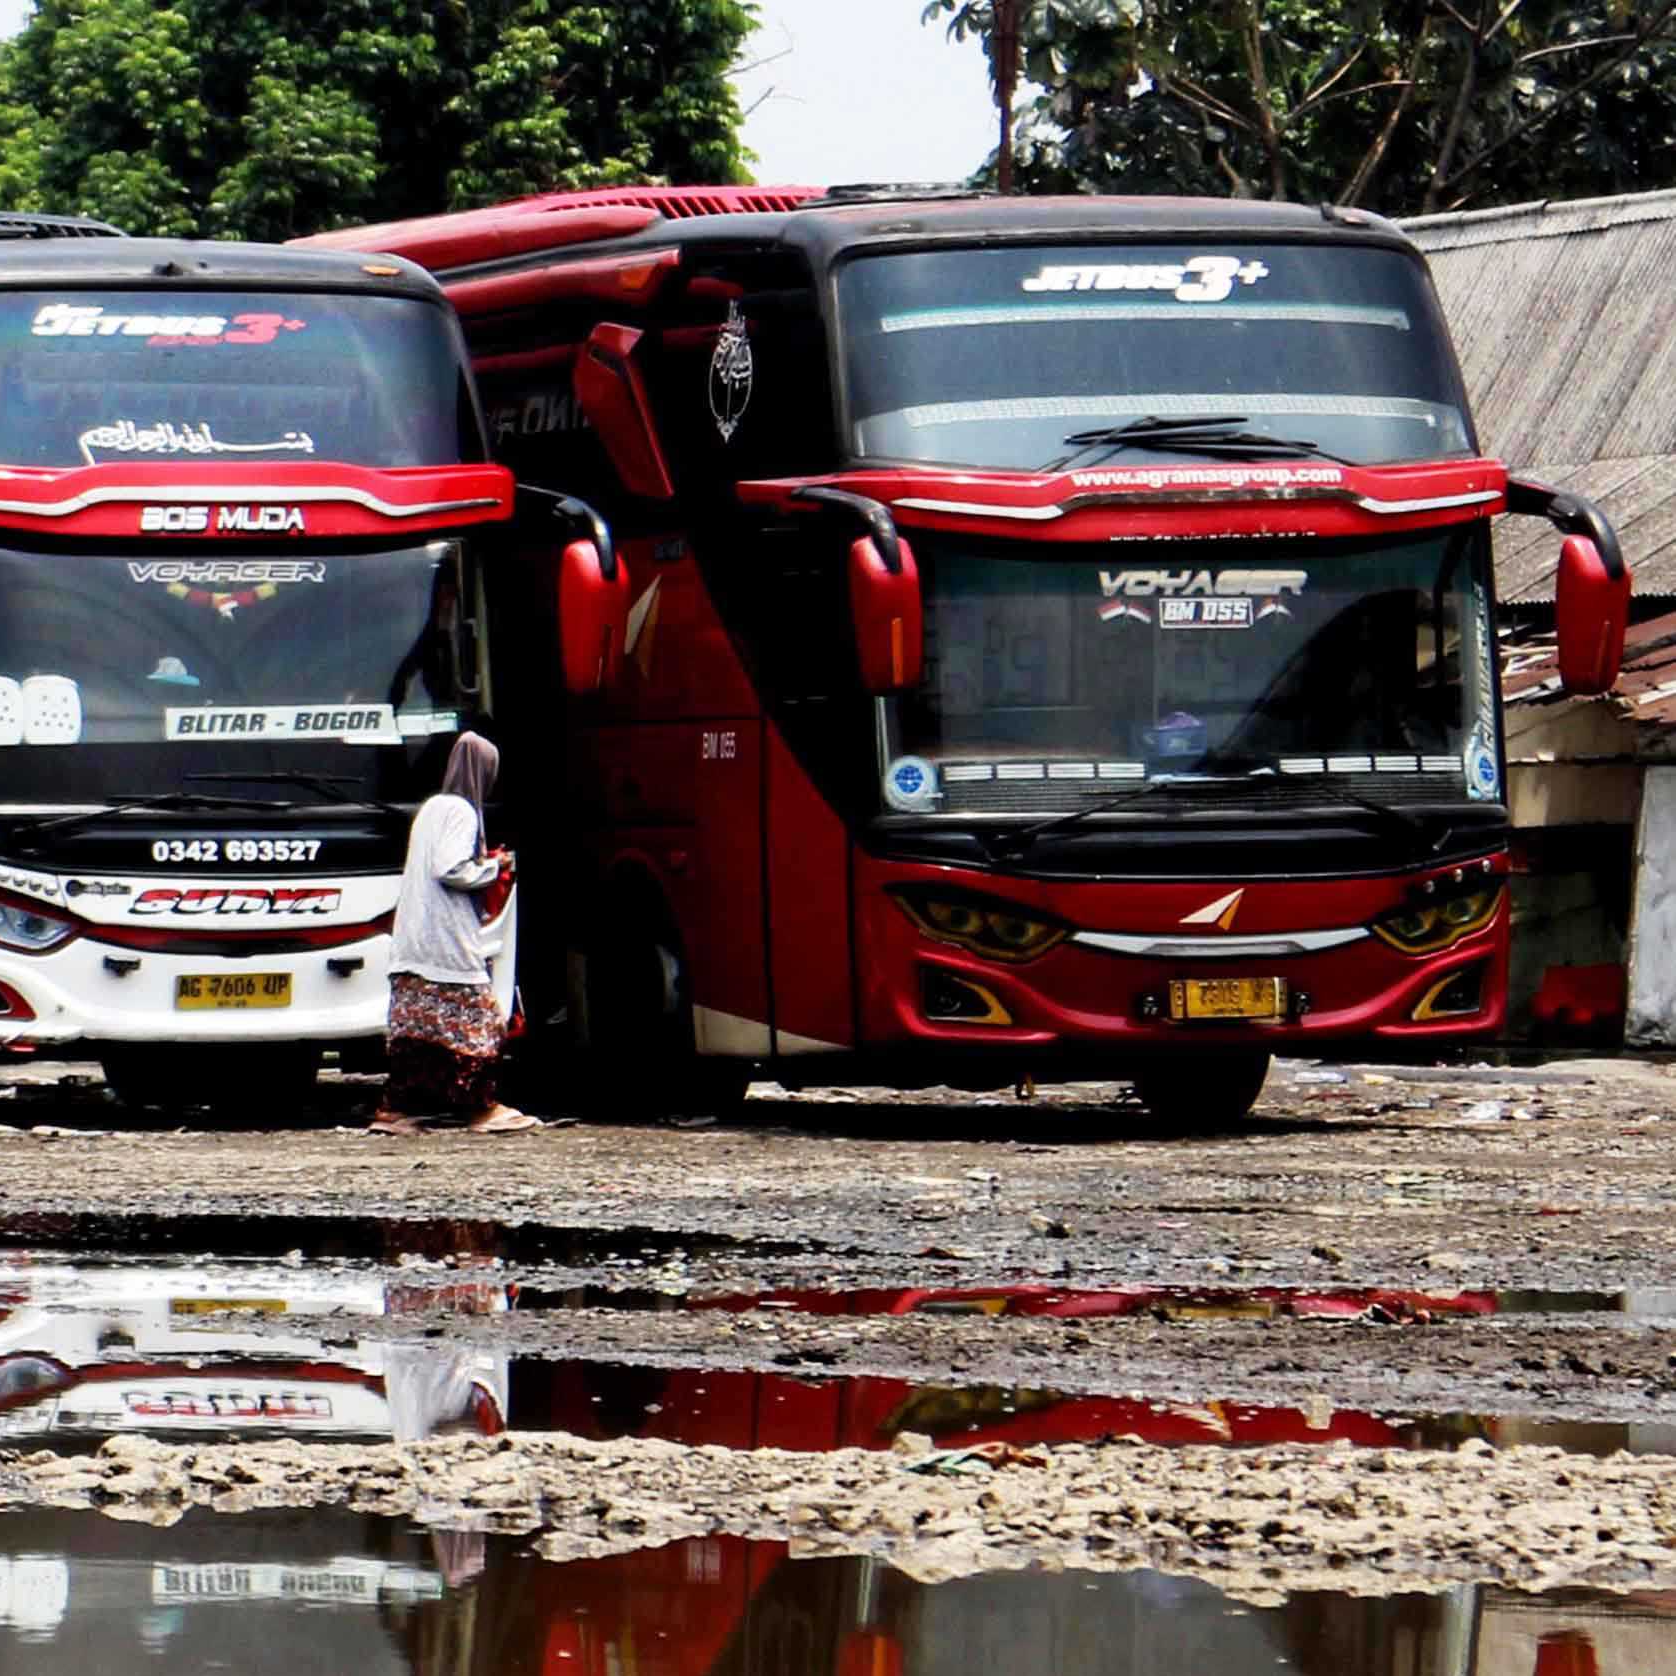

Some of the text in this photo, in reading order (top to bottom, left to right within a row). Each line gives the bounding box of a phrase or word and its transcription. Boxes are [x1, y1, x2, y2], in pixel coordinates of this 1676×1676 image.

[1070, 467, 1343, 489] www.agramasgroup.com
[140, 506, 306, 532] BOS MUDA
[127, 560, 328, 584] VOYAGER
[1098, 569, 1309, 597] VOYAGER
[176, 713, 268, 735] BLITAR
[293, 710, 384, 732] BOGOR
[152, 839, 322, 862] 0342 693527
